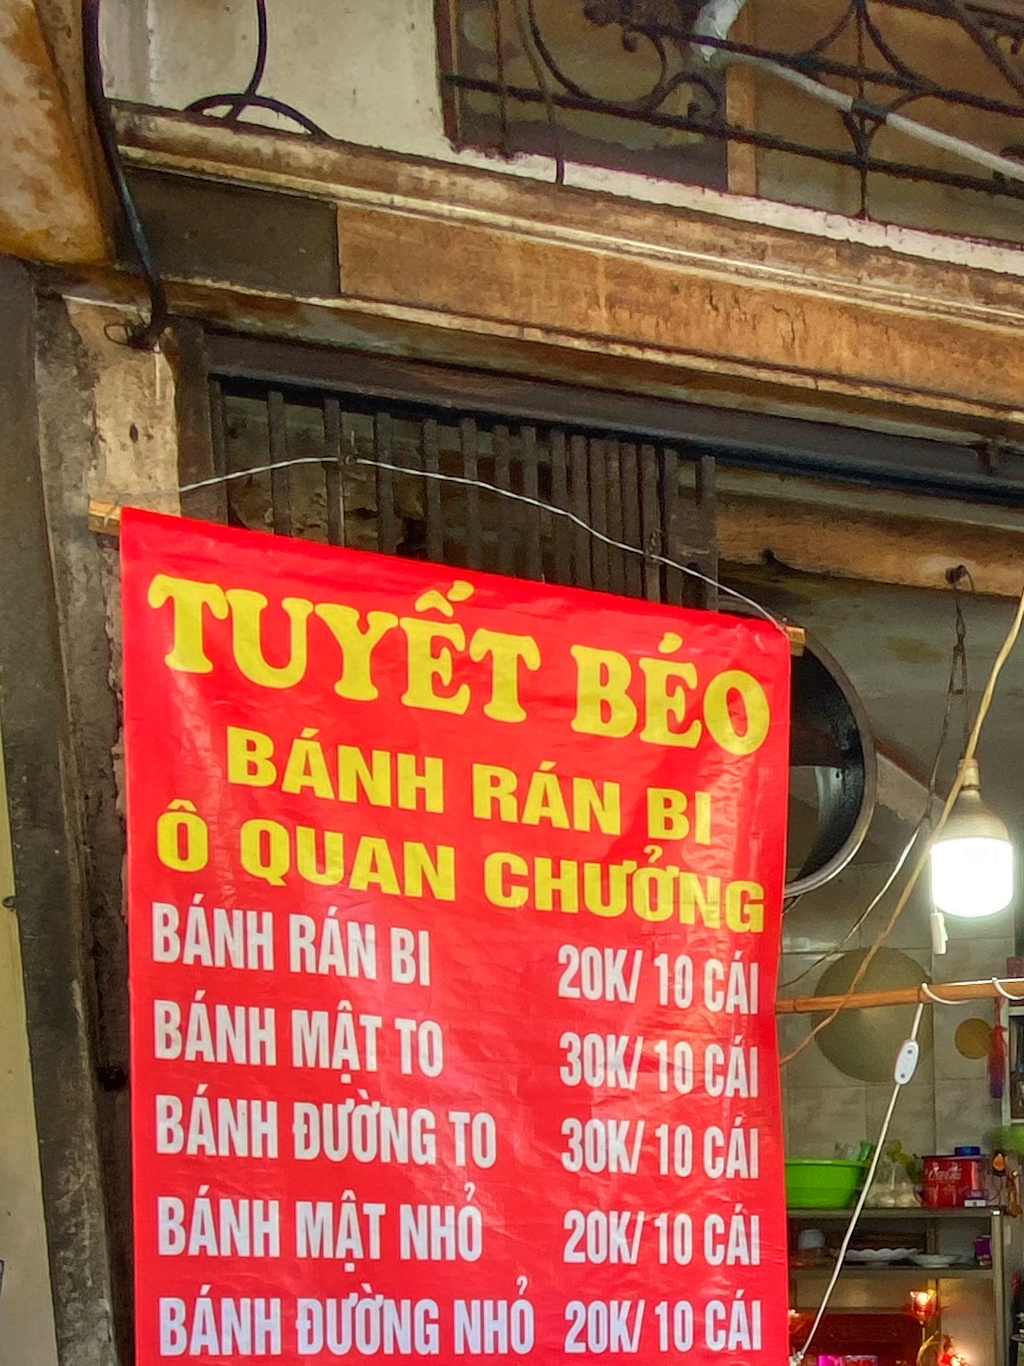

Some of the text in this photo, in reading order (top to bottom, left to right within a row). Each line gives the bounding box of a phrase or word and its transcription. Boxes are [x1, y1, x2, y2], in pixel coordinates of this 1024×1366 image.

[148, 574, 769, 758] TUYẾT BÉO
[228, 726, 712, 846] BÁNH RÁN BI
[158, 799, 764, 933] Ô QUAN CHƯỞNG
[153, 894, 758, 1014] BÁNH RÁN BI 20K/ 10 CÁI
[155, 990, 757, 1098] BÁNH MẬT TO 30K/ 10 CÁI
[157, 1084, 758, 1178] BÁNH ĐƯỜNG TO 30K/ 10 CÁI
[158, 1182, 760, 1271] BÁNH MẬT NHỎ 20K/ 10 CÁI
[160, 1276, 761, 1355] BÁNH ĐƯỜNG NHỎ 20K/ 10 CÁI
